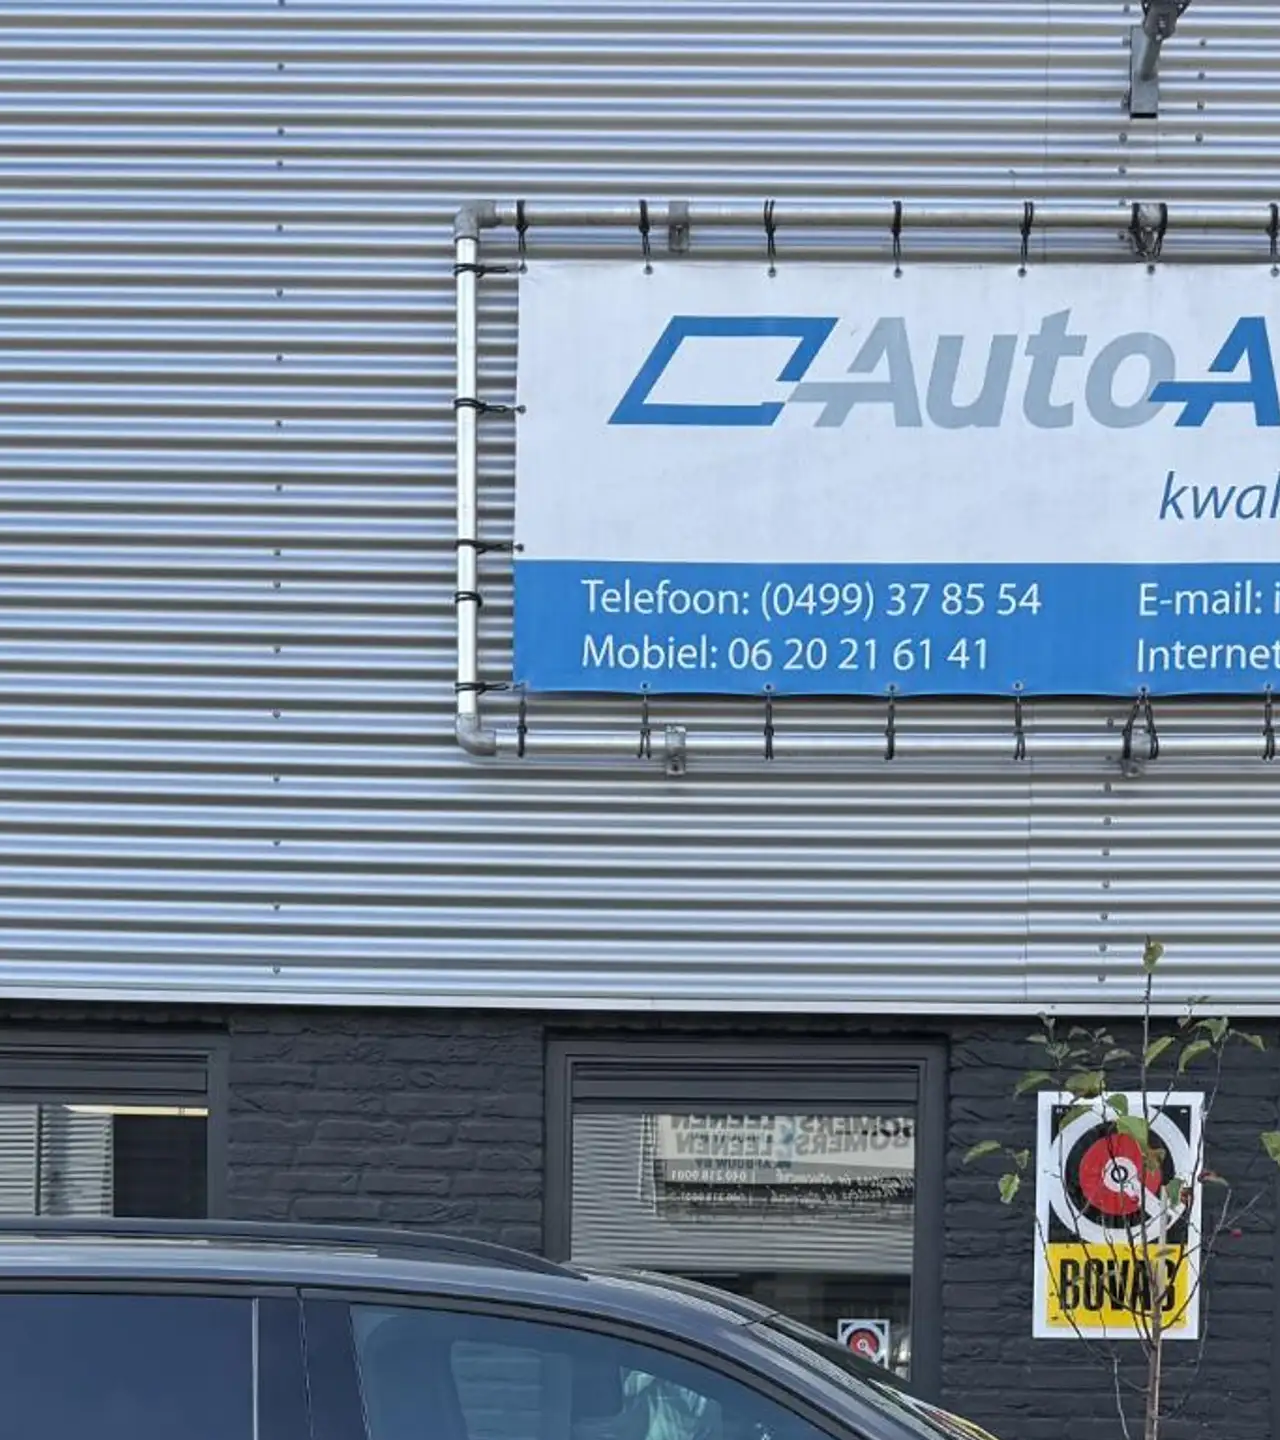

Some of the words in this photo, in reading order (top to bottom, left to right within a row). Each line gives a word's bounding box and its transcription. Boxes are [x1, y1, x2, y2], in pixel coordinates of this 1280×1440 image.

[581, 578, 750, 616] Telefoon:
[761, 582, 875, 622] (0499)
[886, 583, 930, 616] 37
[941, 583, 985, 616] 85
[997, 583, 1042, 616] 54
[1138, 579, 1262, 617] E-mail:
[581, 633, 718, 670] Mobiel:
[728, 637, 773, 671] 06
[783, 637, 827, 671] 20
[838, 638, 876, 671] 21
[892, 638, 931, 671] 61
[947, 638, 987, 671] 41
